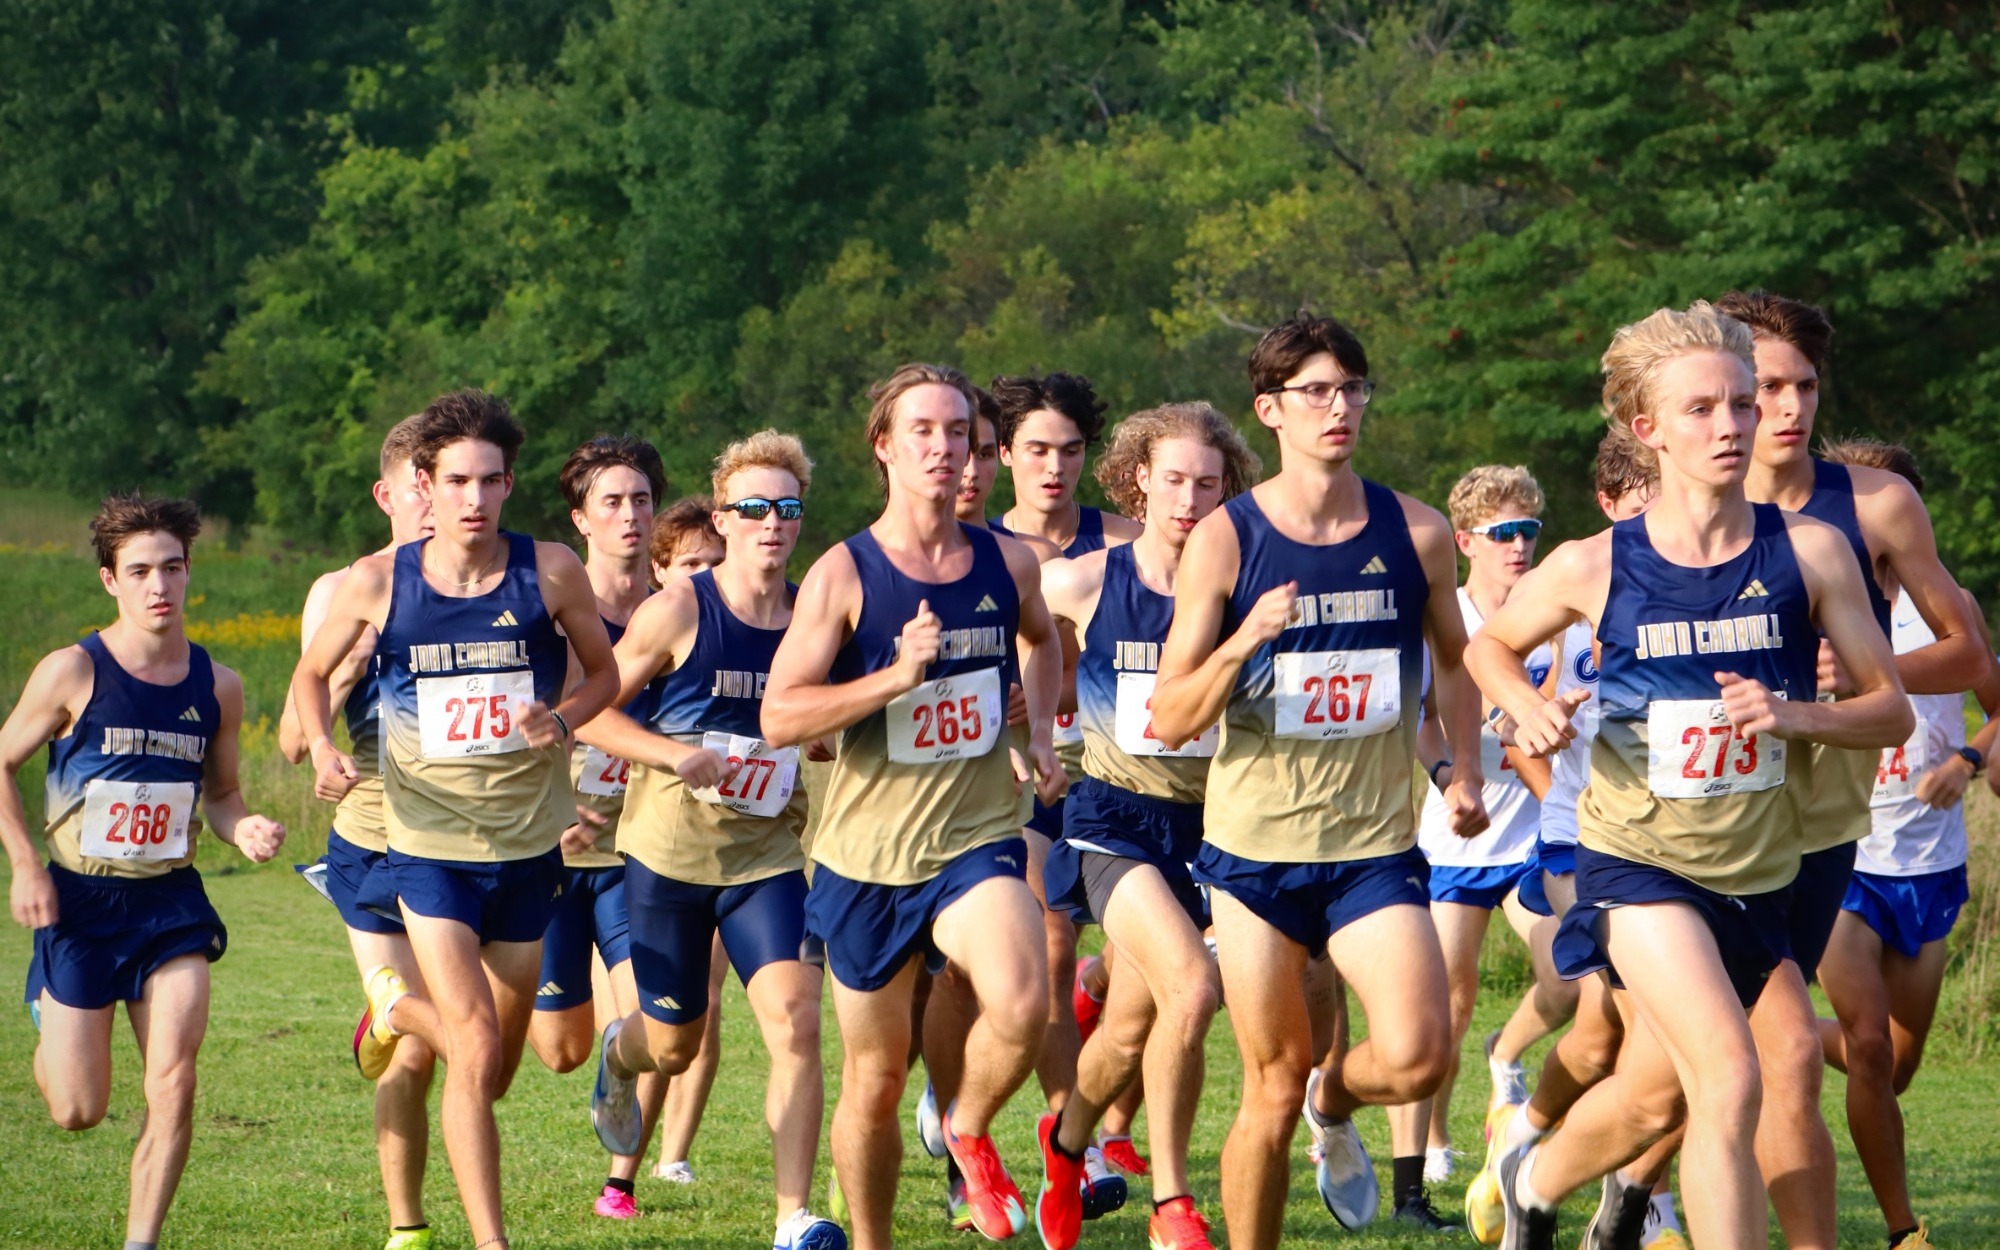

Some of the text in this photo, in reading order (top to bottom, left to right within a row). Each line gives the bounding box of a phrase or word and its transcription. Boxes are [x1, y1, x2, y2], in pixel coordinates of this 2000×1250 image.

[1319, 589, 1398, 624] CARROLL
[409, 643, 453, 673] JOHN
[454, 640, 530, 669] CARROLL
[939, 626, 1007, 661] CARROLL
[1113, 641, 1158, 671] JOHN
[1635, 613, 1783, 660] JOHN CARROLL
[711, 670, 753, 699] JOHN
[1303, 674, 1373, 724] 267
[445, 694, 511, 742] 275
[913, 695, 982, 749] 265
[101, 727, 207, 763] JOHN CARROLL
[1681, 725, 1758, 779] 273
[718, 755, 776, 800] 277
[105, 802, 171, 845] 268
